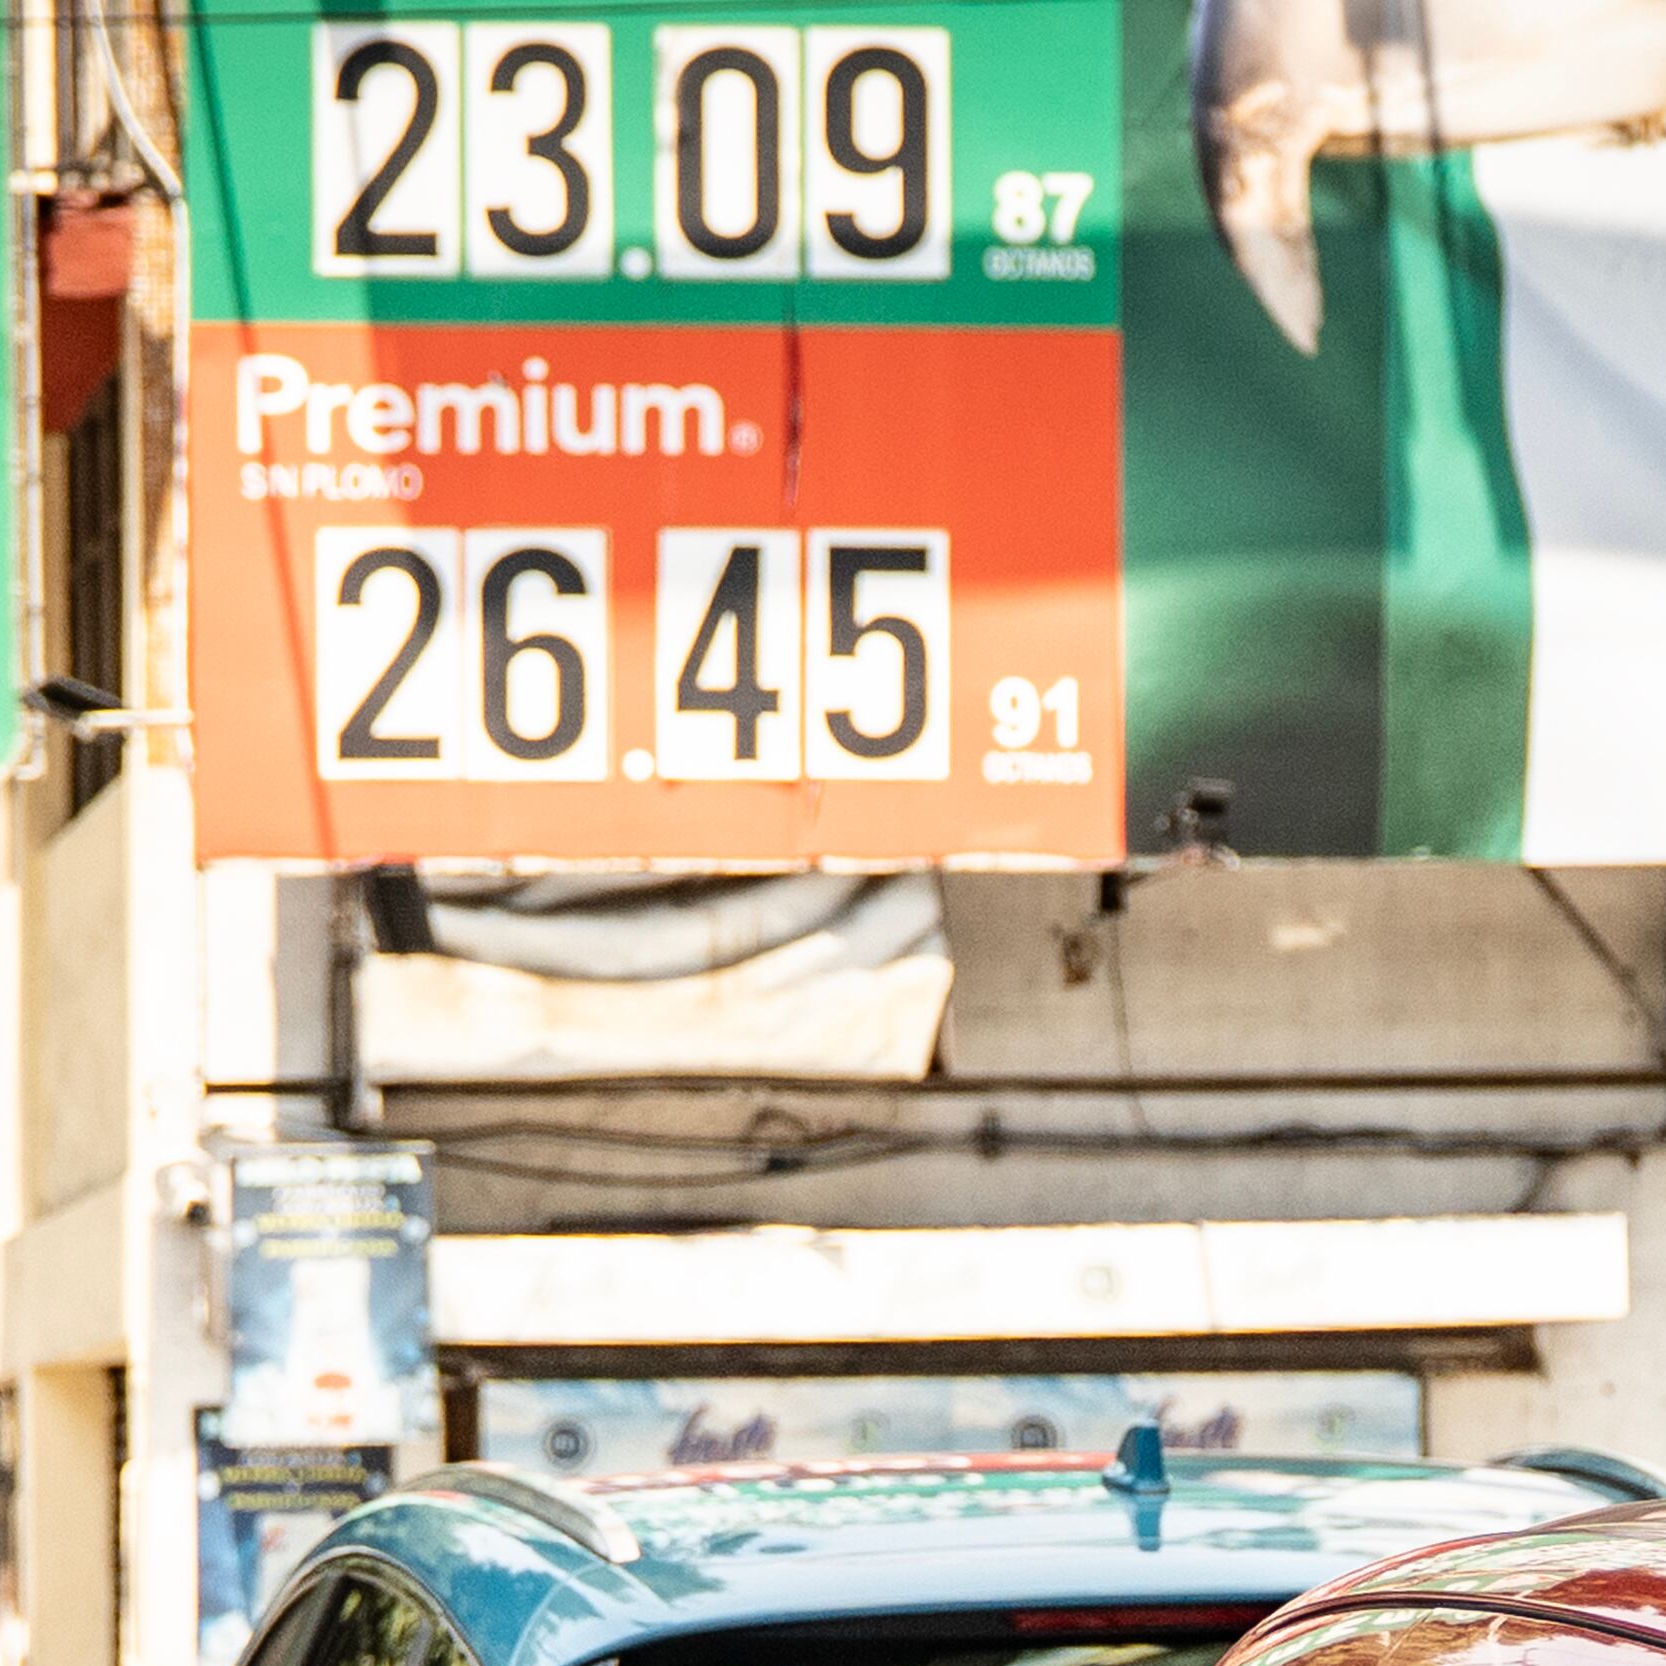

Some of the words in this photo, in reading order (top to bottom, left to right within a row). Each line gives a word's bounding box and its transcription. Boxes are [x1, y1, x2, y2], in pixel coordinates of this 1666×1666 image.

[334, 42, 927, 280] 23.09
[992, 170, 1095, 246] 87
[301, 461, 424, 502] PLOMO
[336, 545, 927, 783] 26.45
[989, 675, 1080, 750] 91
